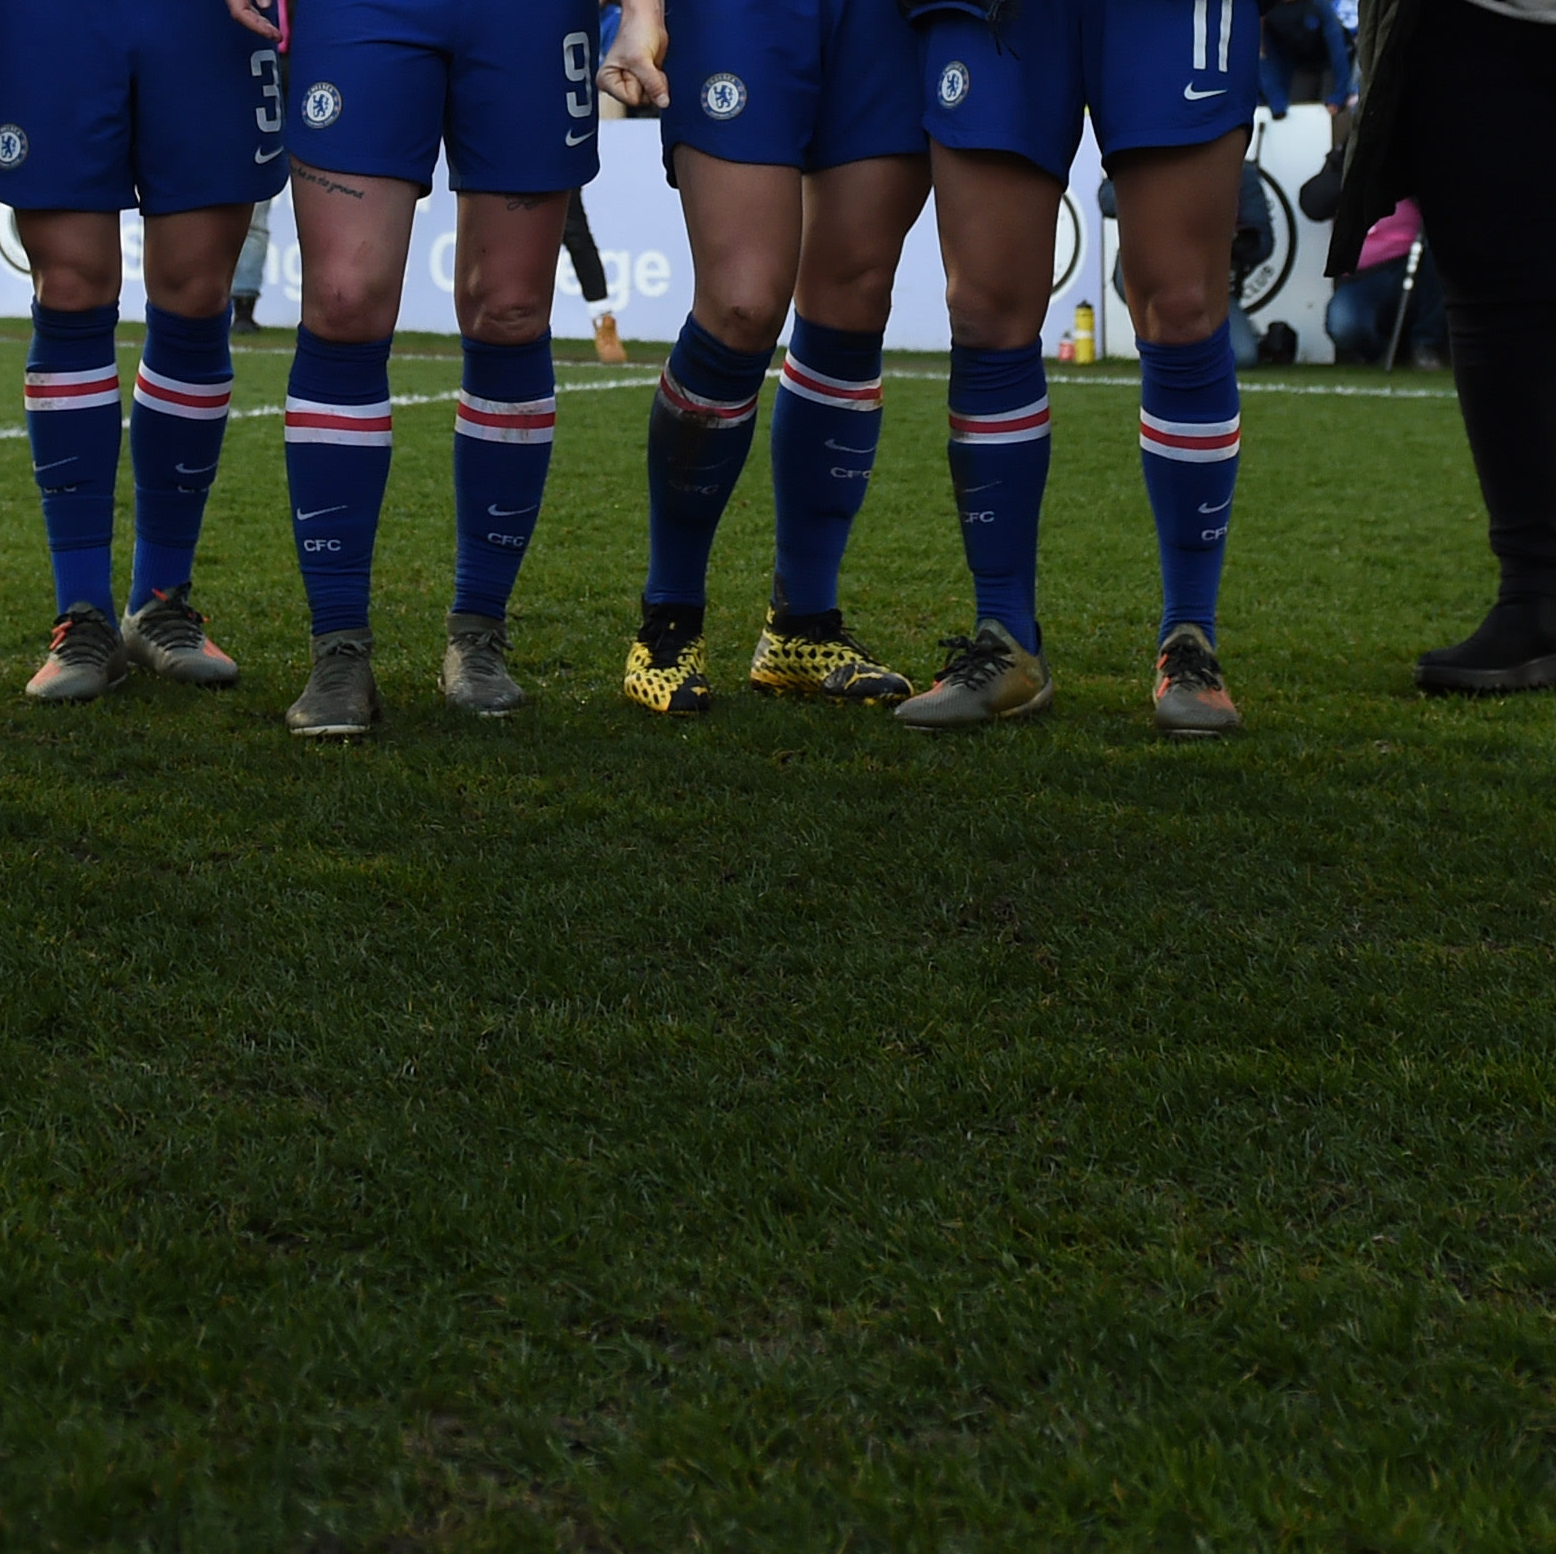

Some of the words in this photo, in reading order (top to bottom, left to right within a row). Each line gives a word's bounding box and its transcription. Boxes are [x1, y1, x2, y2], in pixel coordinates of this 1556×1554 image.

[250, 48, 284, 133] 3
[562, 31, 592, 119] 9
[303, 538, 342, 552] CFC
[487, 532, 526, 547] CFC
